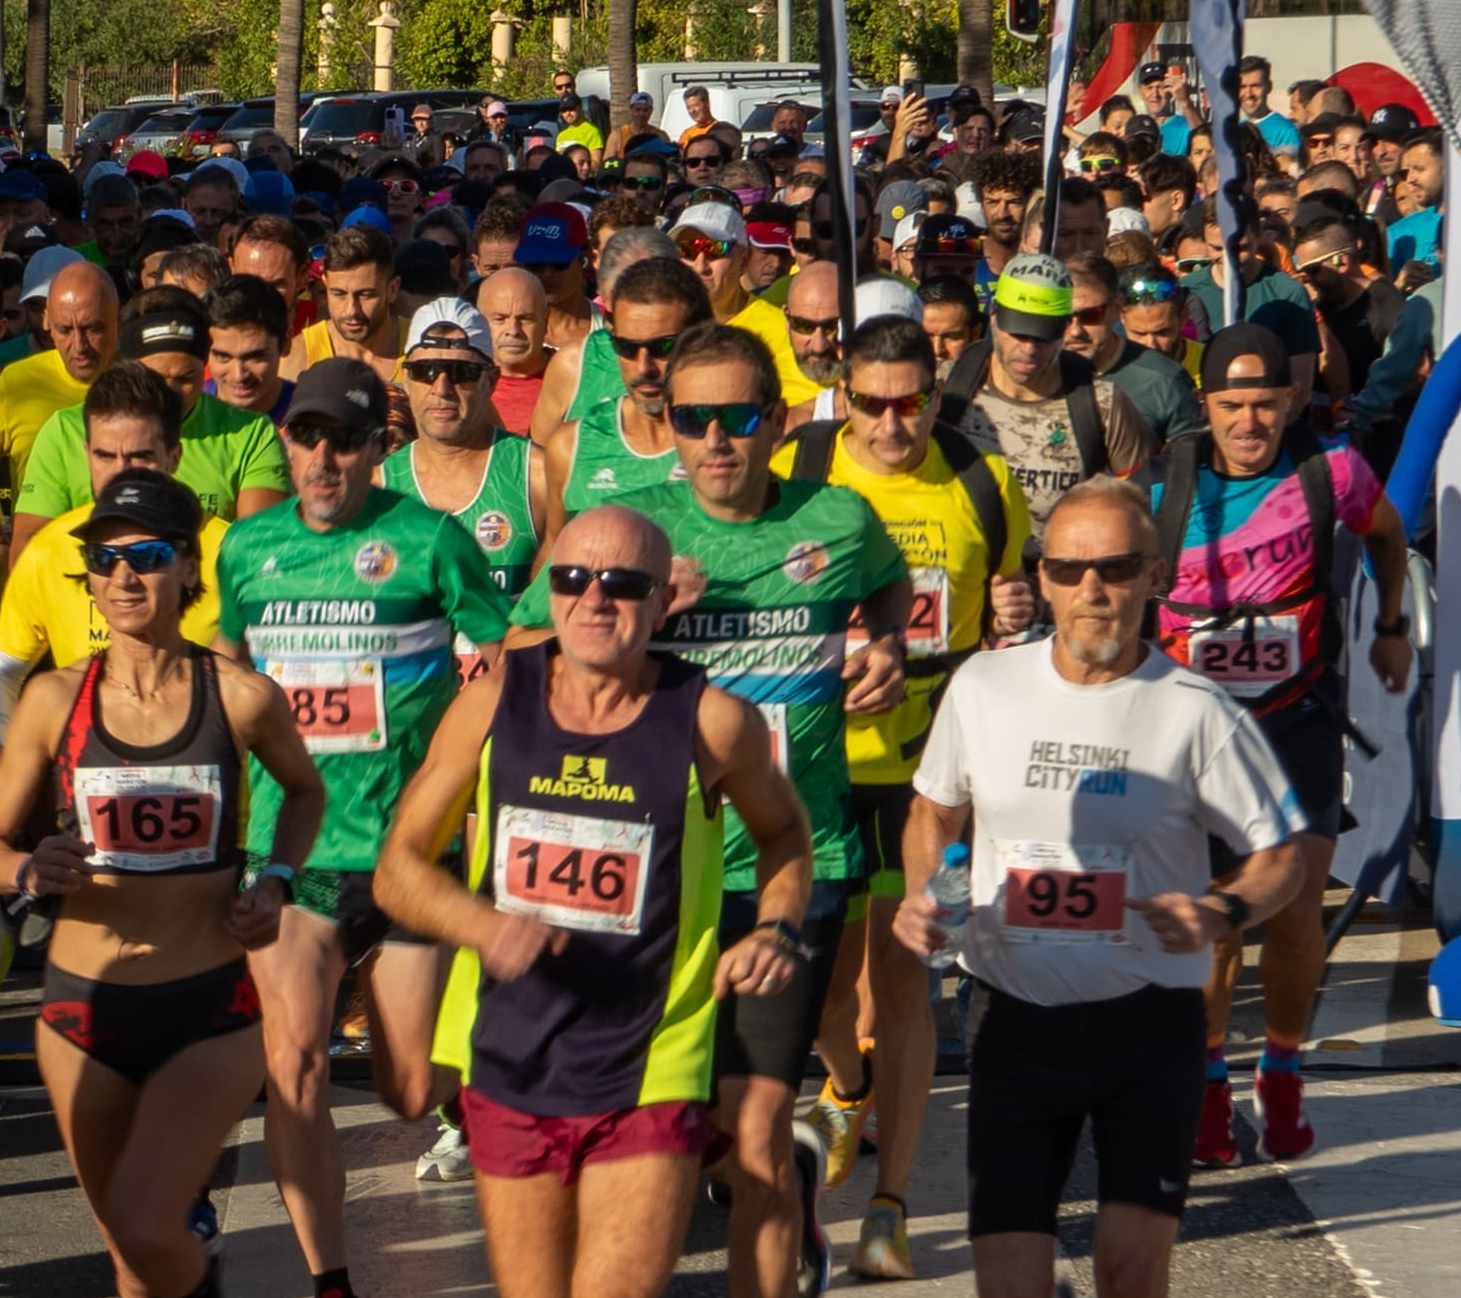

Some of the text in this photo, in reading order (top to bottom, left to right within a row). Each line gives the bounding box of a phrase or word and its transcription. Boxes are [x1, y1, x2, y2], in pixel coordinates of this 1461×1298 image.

[260, 600, 377, 625] ATLETISMO
[673, 605, 810, 638] ATLETISMO
[1202, 642, 1288, 673] 243
[291, 687, 351, 726] 85
[1029, 740, 1131, 771] HELSINKI
[529, 775, 636, 804] MAPOMA
[95, 795, 202, 843] 165
[516, 841, 626, 901] 146
[1027, 873, 1099, 920] 95
